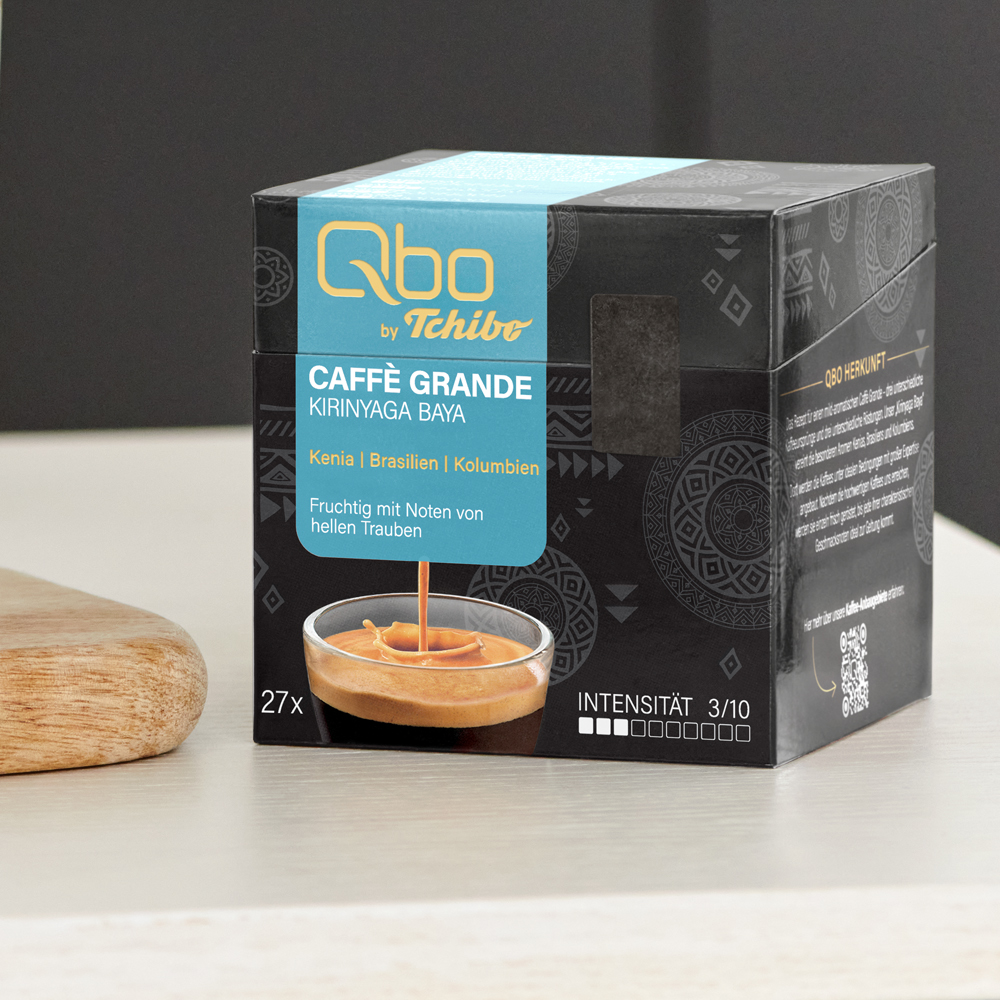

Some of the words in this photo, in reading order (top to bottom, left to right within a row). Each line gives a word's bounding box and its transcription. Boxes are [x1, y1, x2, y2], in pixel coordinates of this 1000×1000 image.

[317, 221, 494, 305] Qbo
[381, 323, 398, 340] by
[404, 308, 533, 341] Tchibo
[309, 363, 400, 393] CAFFÈ
[410, 370, 532, 400] GRANDE
[825, 366, 843, 389] QBO
[844, 351, 886, 381] HERKUNFT
[310, 397, 411, 420] KIRINYAGA
[420, 403, 465, 423] BAYA
[310, 450, 354, 466] Kenia
[370, 452, 438, 470] Brasilien
[455, 457, 539, 475] Kolumbien
[311, 498, 371, 518] Fruchtig
[378, 503, 400, 516] mit
[407, 503, 451, 519] Noten
[456, 509, 483, 520] von
[312, 518, 355, 534] hellen
[361, 521, 421, 537] Trauben
[262, 690, 303, 714] 27x
[579, 692, 693, 716] INTENSITÄT
[709, 699, 749, 719] 3/10
